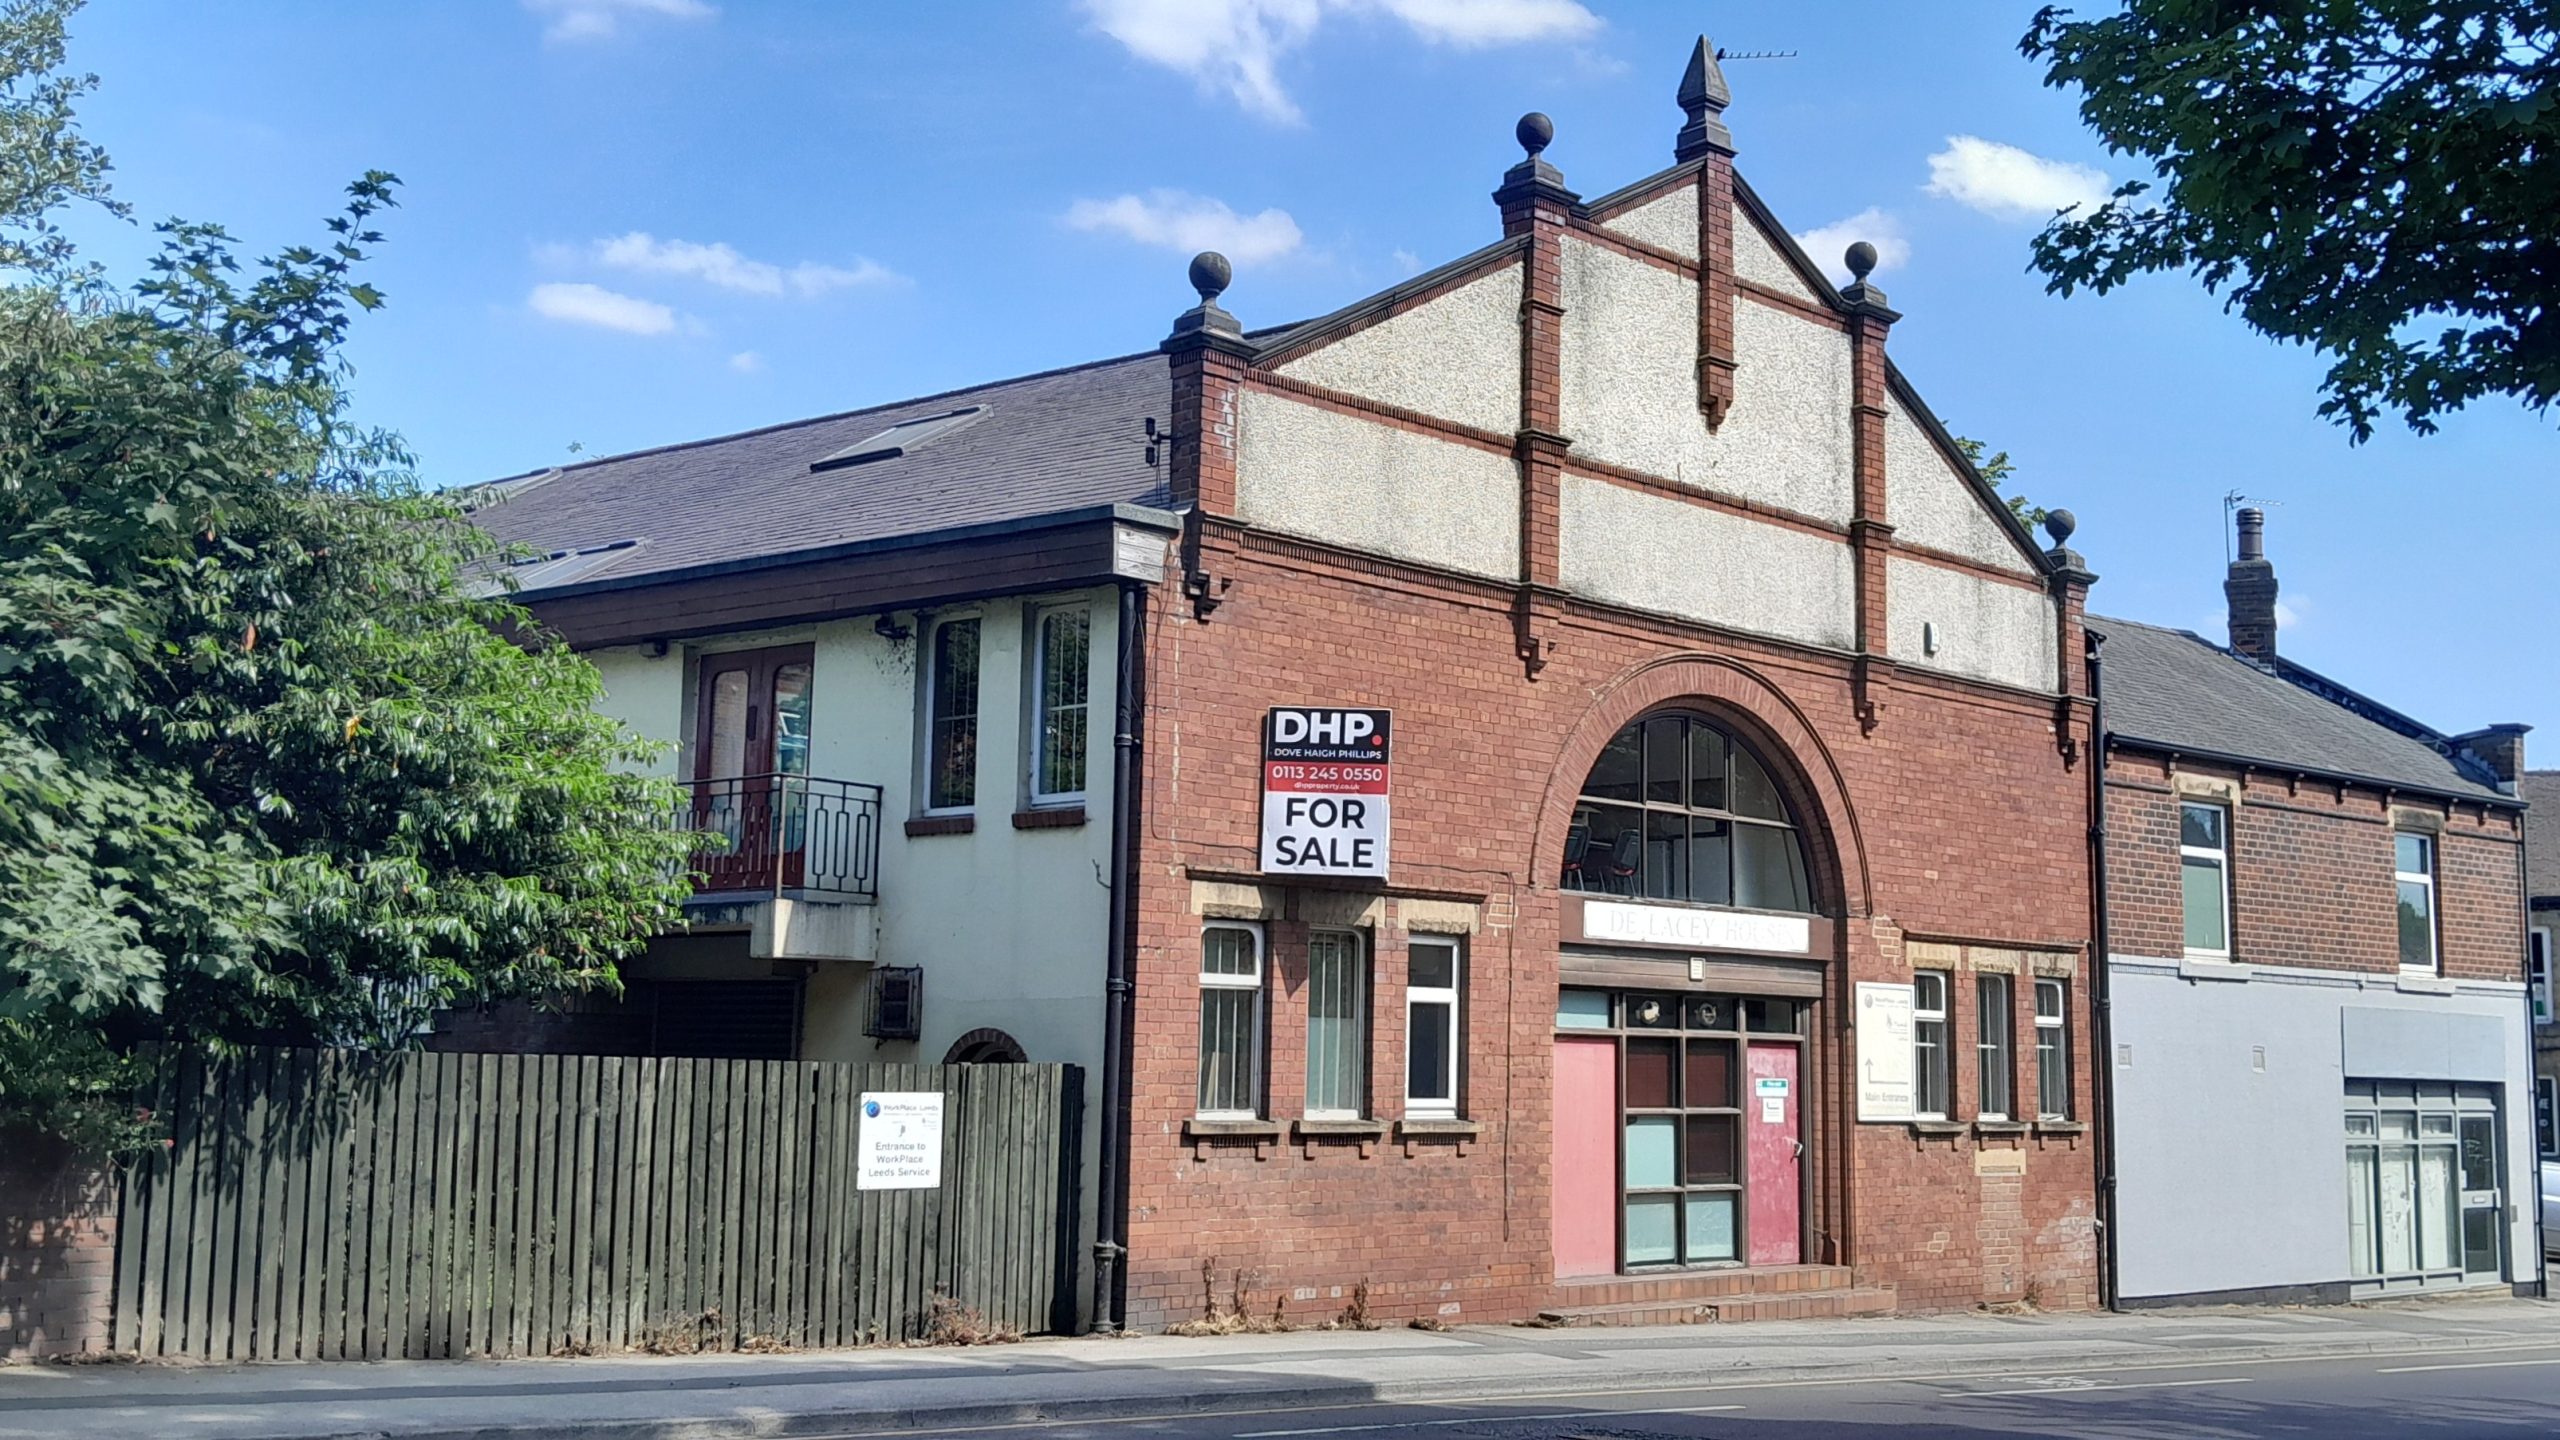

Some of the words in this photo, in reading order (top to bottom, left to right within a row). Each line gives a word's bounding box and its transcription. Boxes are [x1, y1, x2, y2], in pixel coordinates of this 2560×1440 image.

[1274, 748, 1302, 757] DOVE
[1304, 749, 1335, 758] HAIGH
[1338, 750, 1382, 759] PHILLIPS
[1272, 766, 1305, 779] 0113
[1309, 767, 1338, 780] 245
[1343, 768, 1383, 781] 0550
[1294, 782, 1361, 791] dhpproperty.co.uk
[1286, 797, 1366, 829] FOR
[1275, 835, 1374, 868] SALE
[1610, 910, 1636, 934] DE
[1649, 913, 1715, 940] LACEY
[1865, 1091, 1881, 1101] Main
[875, 1142, 915, 1151] Entrance
[917, 1142, 926, 1151] to
[876, 1154, 924, 1164] WorkPlace
[868, 1167, 895, 1177] Leeds
[898, 1167, 930, 1177] Service
